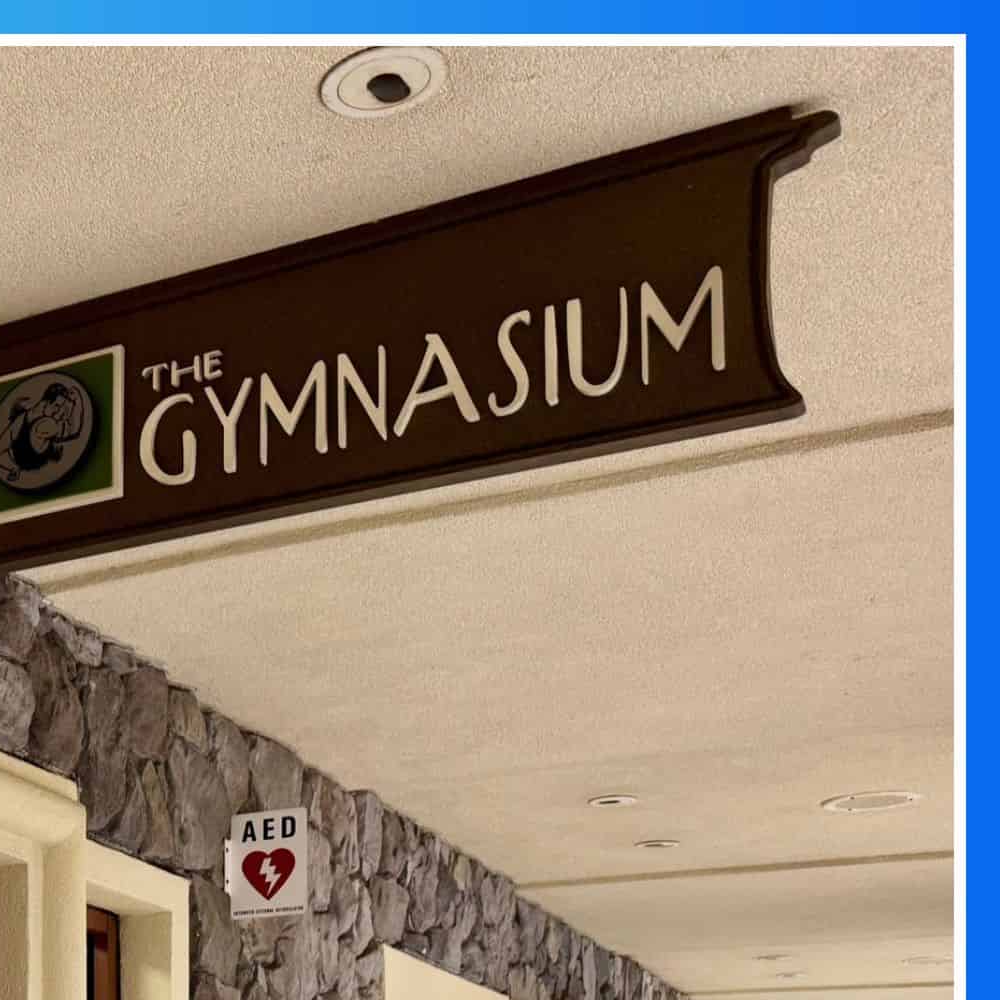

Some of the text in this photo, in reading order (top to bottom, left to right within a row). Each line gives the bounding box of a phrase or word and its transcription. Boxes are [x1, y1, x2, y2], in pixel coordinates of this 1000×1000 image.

[139, 264, 727, 486] GYMNASIUM
[142, 350, 223, 392] THE
[242, 815, 296, 843] AED
